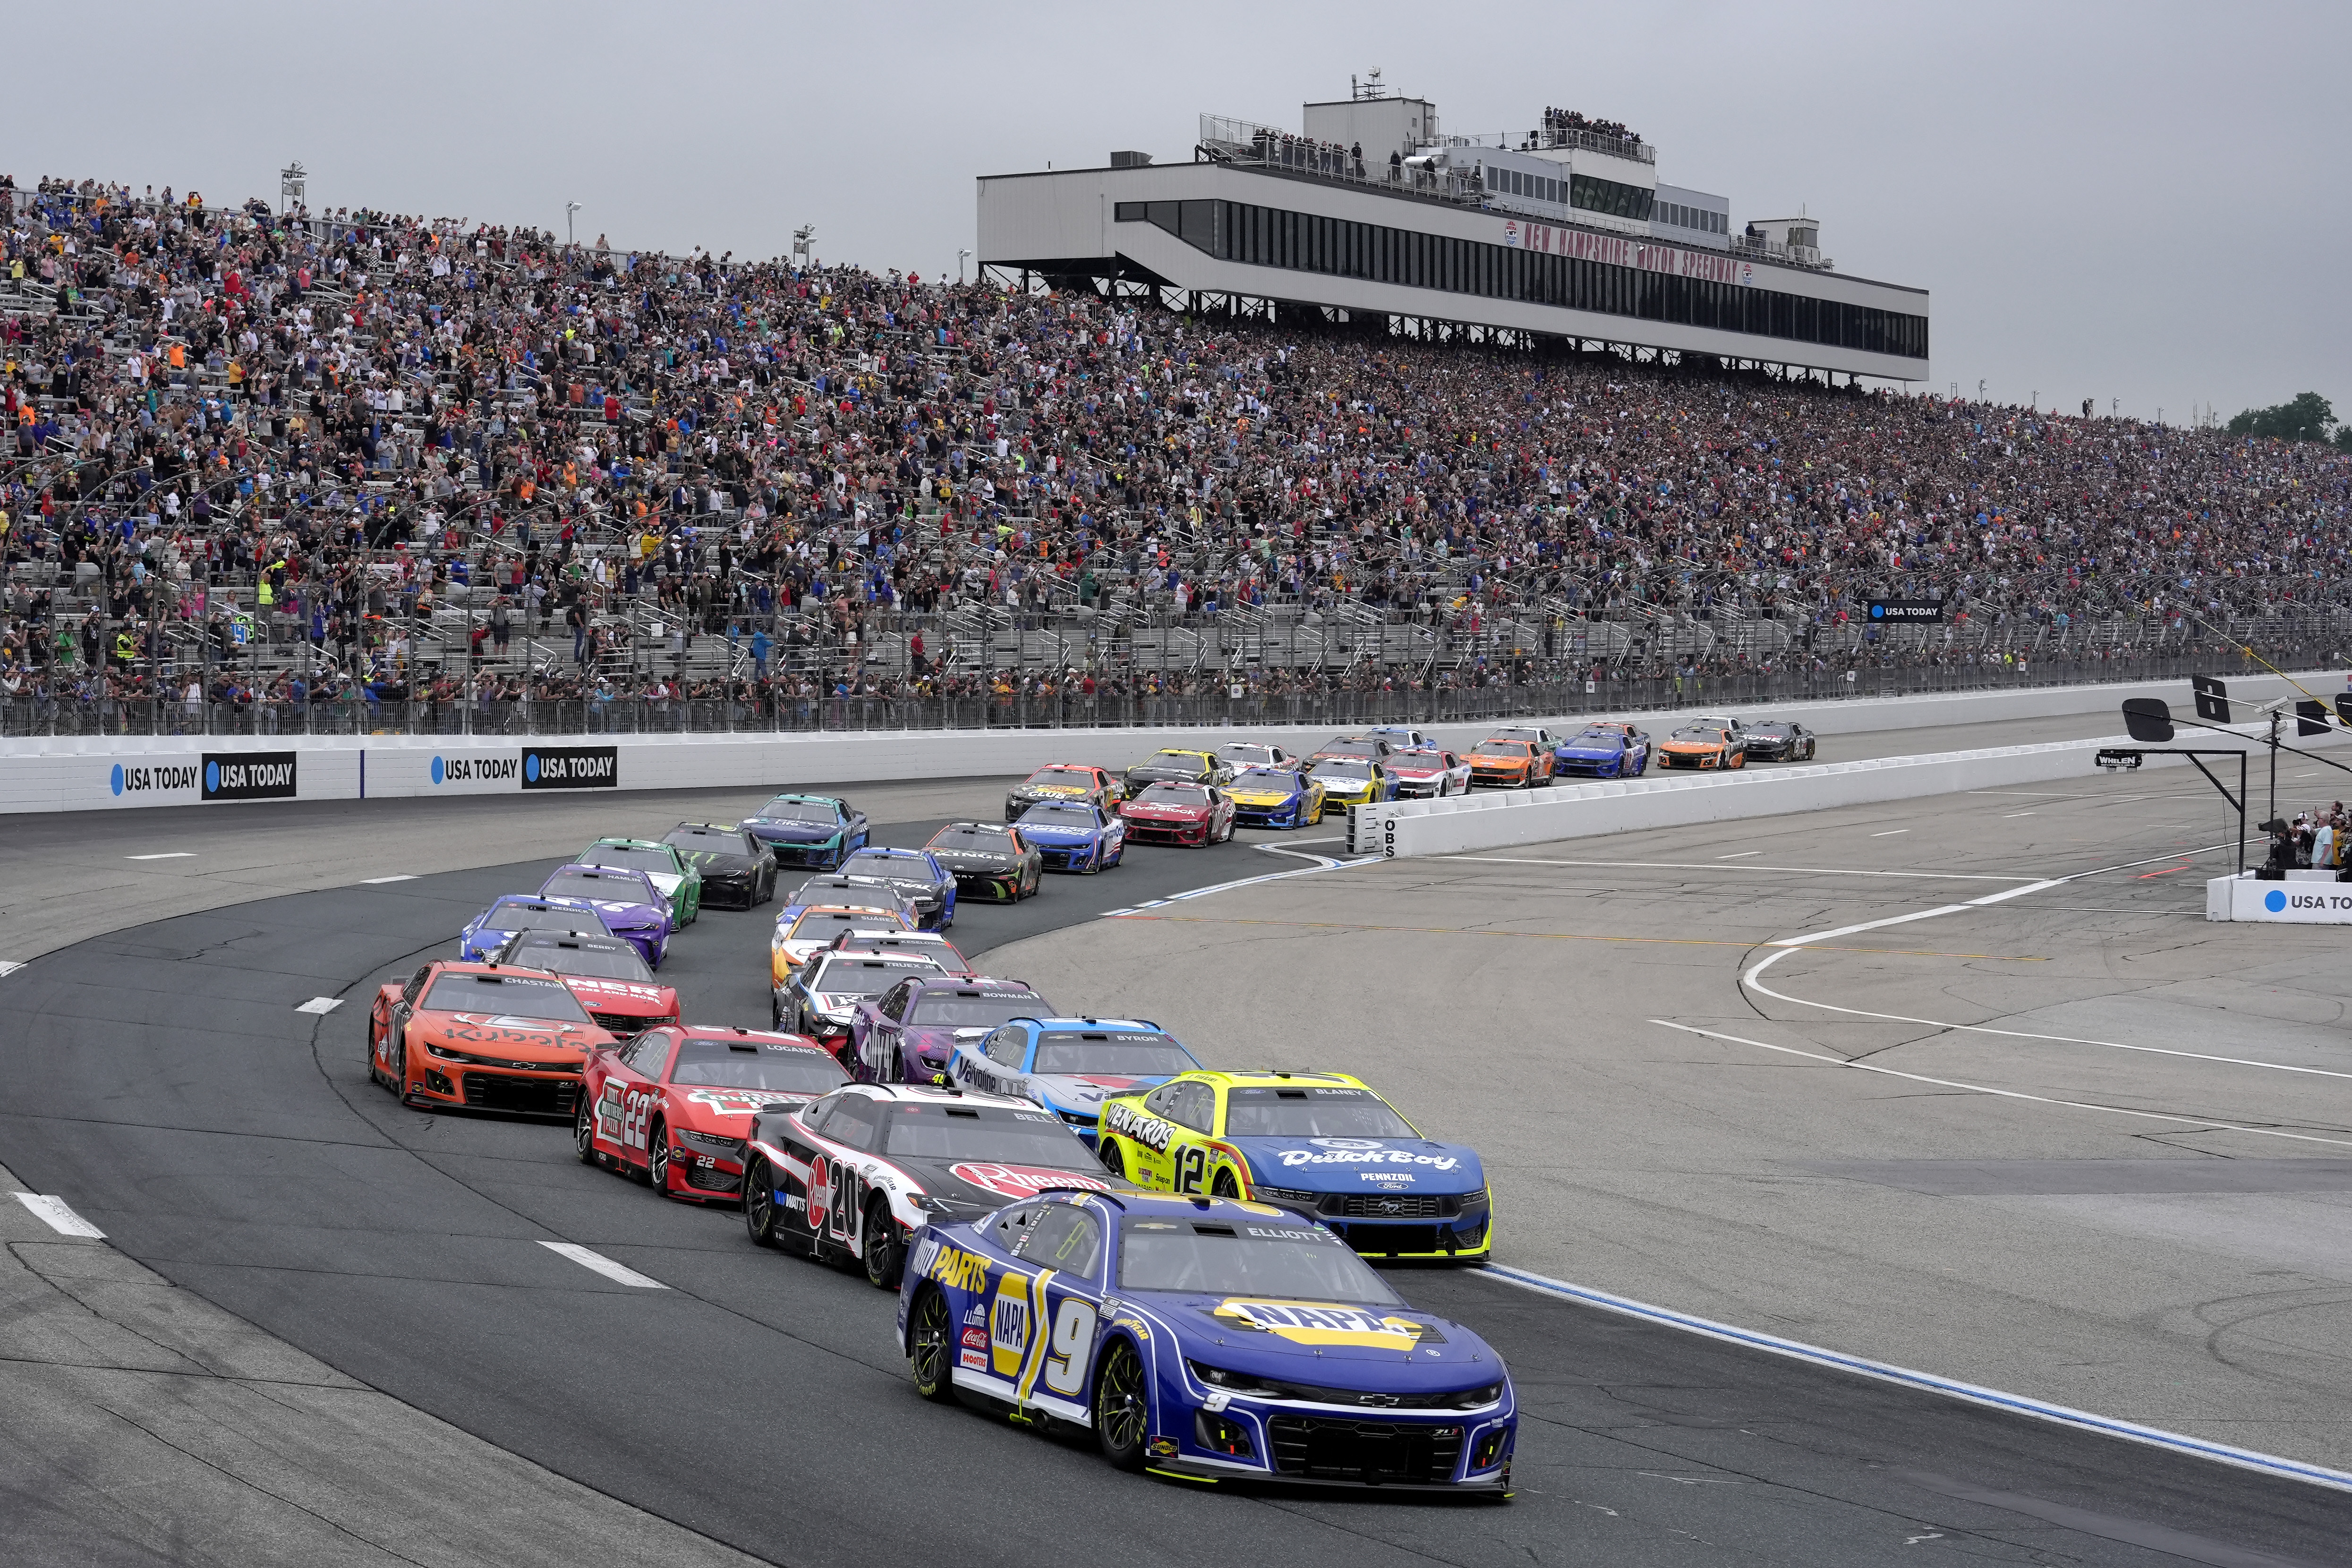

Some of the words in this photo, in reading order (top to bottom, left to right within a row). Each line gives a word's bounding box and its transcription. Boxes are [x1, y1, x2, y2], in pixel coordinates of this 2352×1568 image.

[1525, 223, 1551, 252] NEW
[1559, 229, 1628, 265] HAMPSHIRE
[1637, 245, 1675, 273] MOTOR
[1683, 251, 1738, 284] SPEEDWAY
[1885, 607, 1904, 616] USA
[1906, 607, 1938, 616] TODAY
[445, 759, 471, 780] USA
[474, 758, 518, 779] TODAY
[540, 757, 567, 778] USA
[570, 757, 613, 777] TODAY
[2099, 756, 2136, 764] WHELEN
[126, 767, 151, 791] USA
[154, 766, 197, 789] TODAY
[221, 764, 247, 788] USA
[249, 763, 293, 787] TODAY
[1027, 791, 1066, 800] CLUB
[1126, 804, 1197, 817] Overstock
[1385, 819, 1395, 857] OBS
[552, 905, 588, 913] REDDICK
[2292, 895, 2326, 909] USA
[504, 977, 565, 989] CHASTAIN
[630, 993, 663, 1007] MORE.
[983, 992, 1032, 1000] BOWMAN
[823, 1025, 838, 1035] 19
[446, 1028, 591, 1054] Kubota
[766, 1044, 817, 1055] LOGANO
[956, 1056, 997, 1094] Valvoline
[607, 1086, 619, 1105] HUNT
[1315, 1089, 1362, 1097] BLANEY
[602, 1100, 622, 1120] BROTHERS
[1014, 1113, 1053, 1124] BELL
[606, 1119, 618, 1134] PIZZA
[624, 1090, 650, 1150] 22
[1108, 1103, 1176, 1150] MENARDS
[696, 1155, 716, 1169] 22
[1174, 1144, 1205, 1194] 12
[1278, 1150, 1384, 1167] Dutch
[1379, 1150, 1458, 1170] Boy
[808, 1157, 827, 1217] Rheem
[873, 1175, 896, 1191] GOODYEAR
[963, 1164, 1112, 1193] Rheem
[1155, 1173, 1170, 1185] Snap-on
[1360, 1173, 1416, 1182] PENNZOIL
[785, 1193, 806, 1212] WATTS
[830, 1159, 859, 1241] 20
[1247, 1227, 1322, 1241] ELLIOTT
[911, 1236, 940, 1277] AUTO
[930, 1245, 992, 1295] PARTS
[963, 1309, 985, 1327] LLumar
[995, 1299, 1024, 1348] NAPA
[1240, 1304, 1407, 1333] NAPA
[1112, 1318, 1149, 1340] GOODYEAR
[1045, 1297, 1097, 1397] 9
[963, 1353, 986, 1367] HOOTERS
[1202, 1392, 1231, 1412] 9
[1432, 1428, 1459, 1436] ZL1
[1152, 1443, 1177, 1452] SUNOCO
